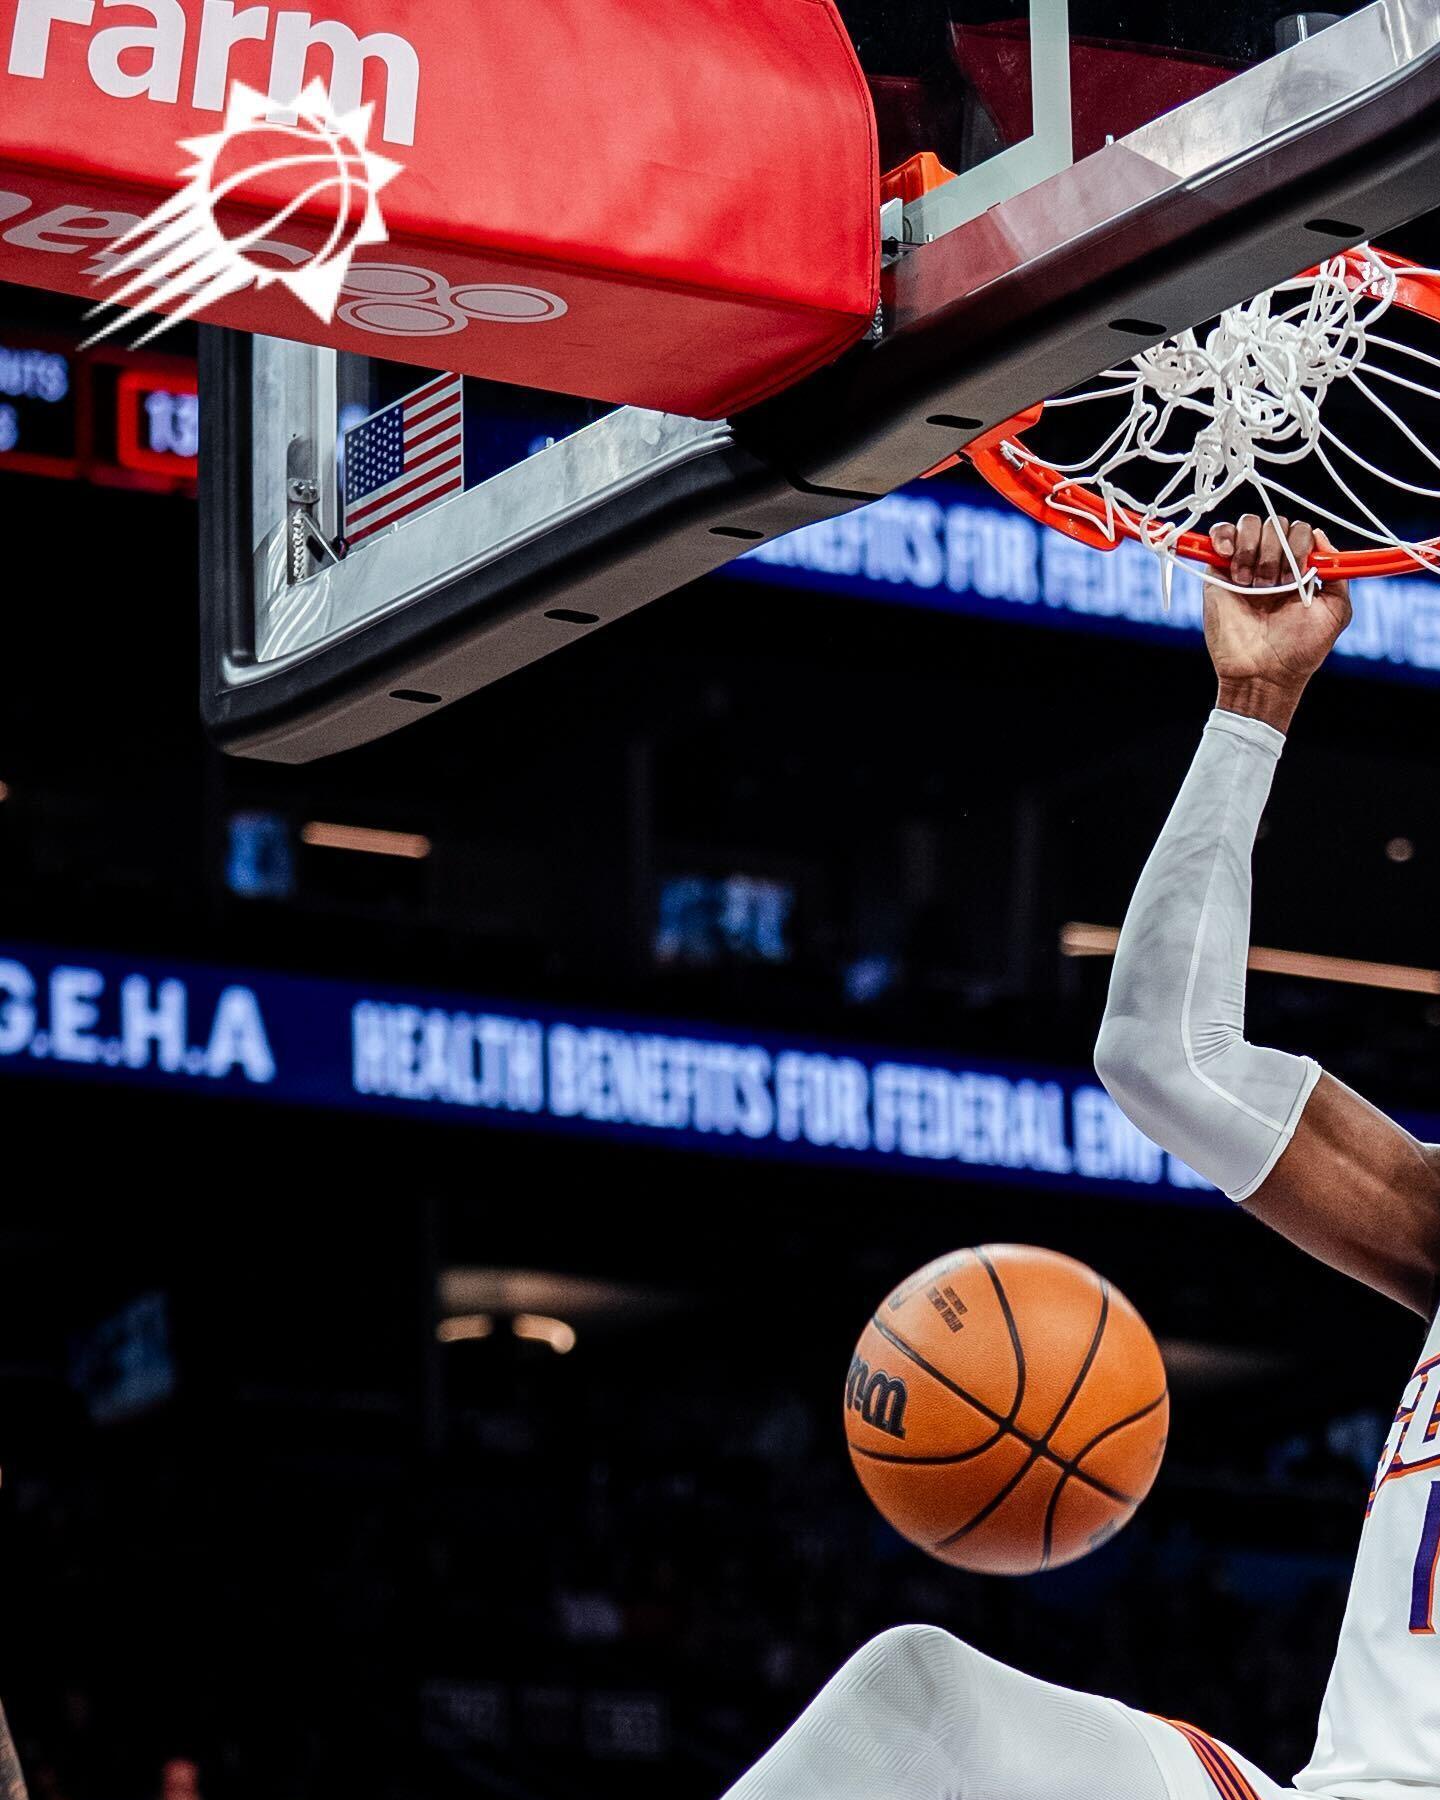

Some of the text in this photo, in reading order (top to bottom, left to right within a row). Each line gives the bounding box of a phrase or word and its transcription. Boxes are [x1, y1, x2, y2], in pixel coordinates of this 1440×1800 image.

[352, 1000, 543, 1114] HEALTH
[547, 1021, 775, 1139] BENEFITS
[776, 1048, 869, 1151] FOR
[872, 1061, 1072, 1174] FEDERAL
